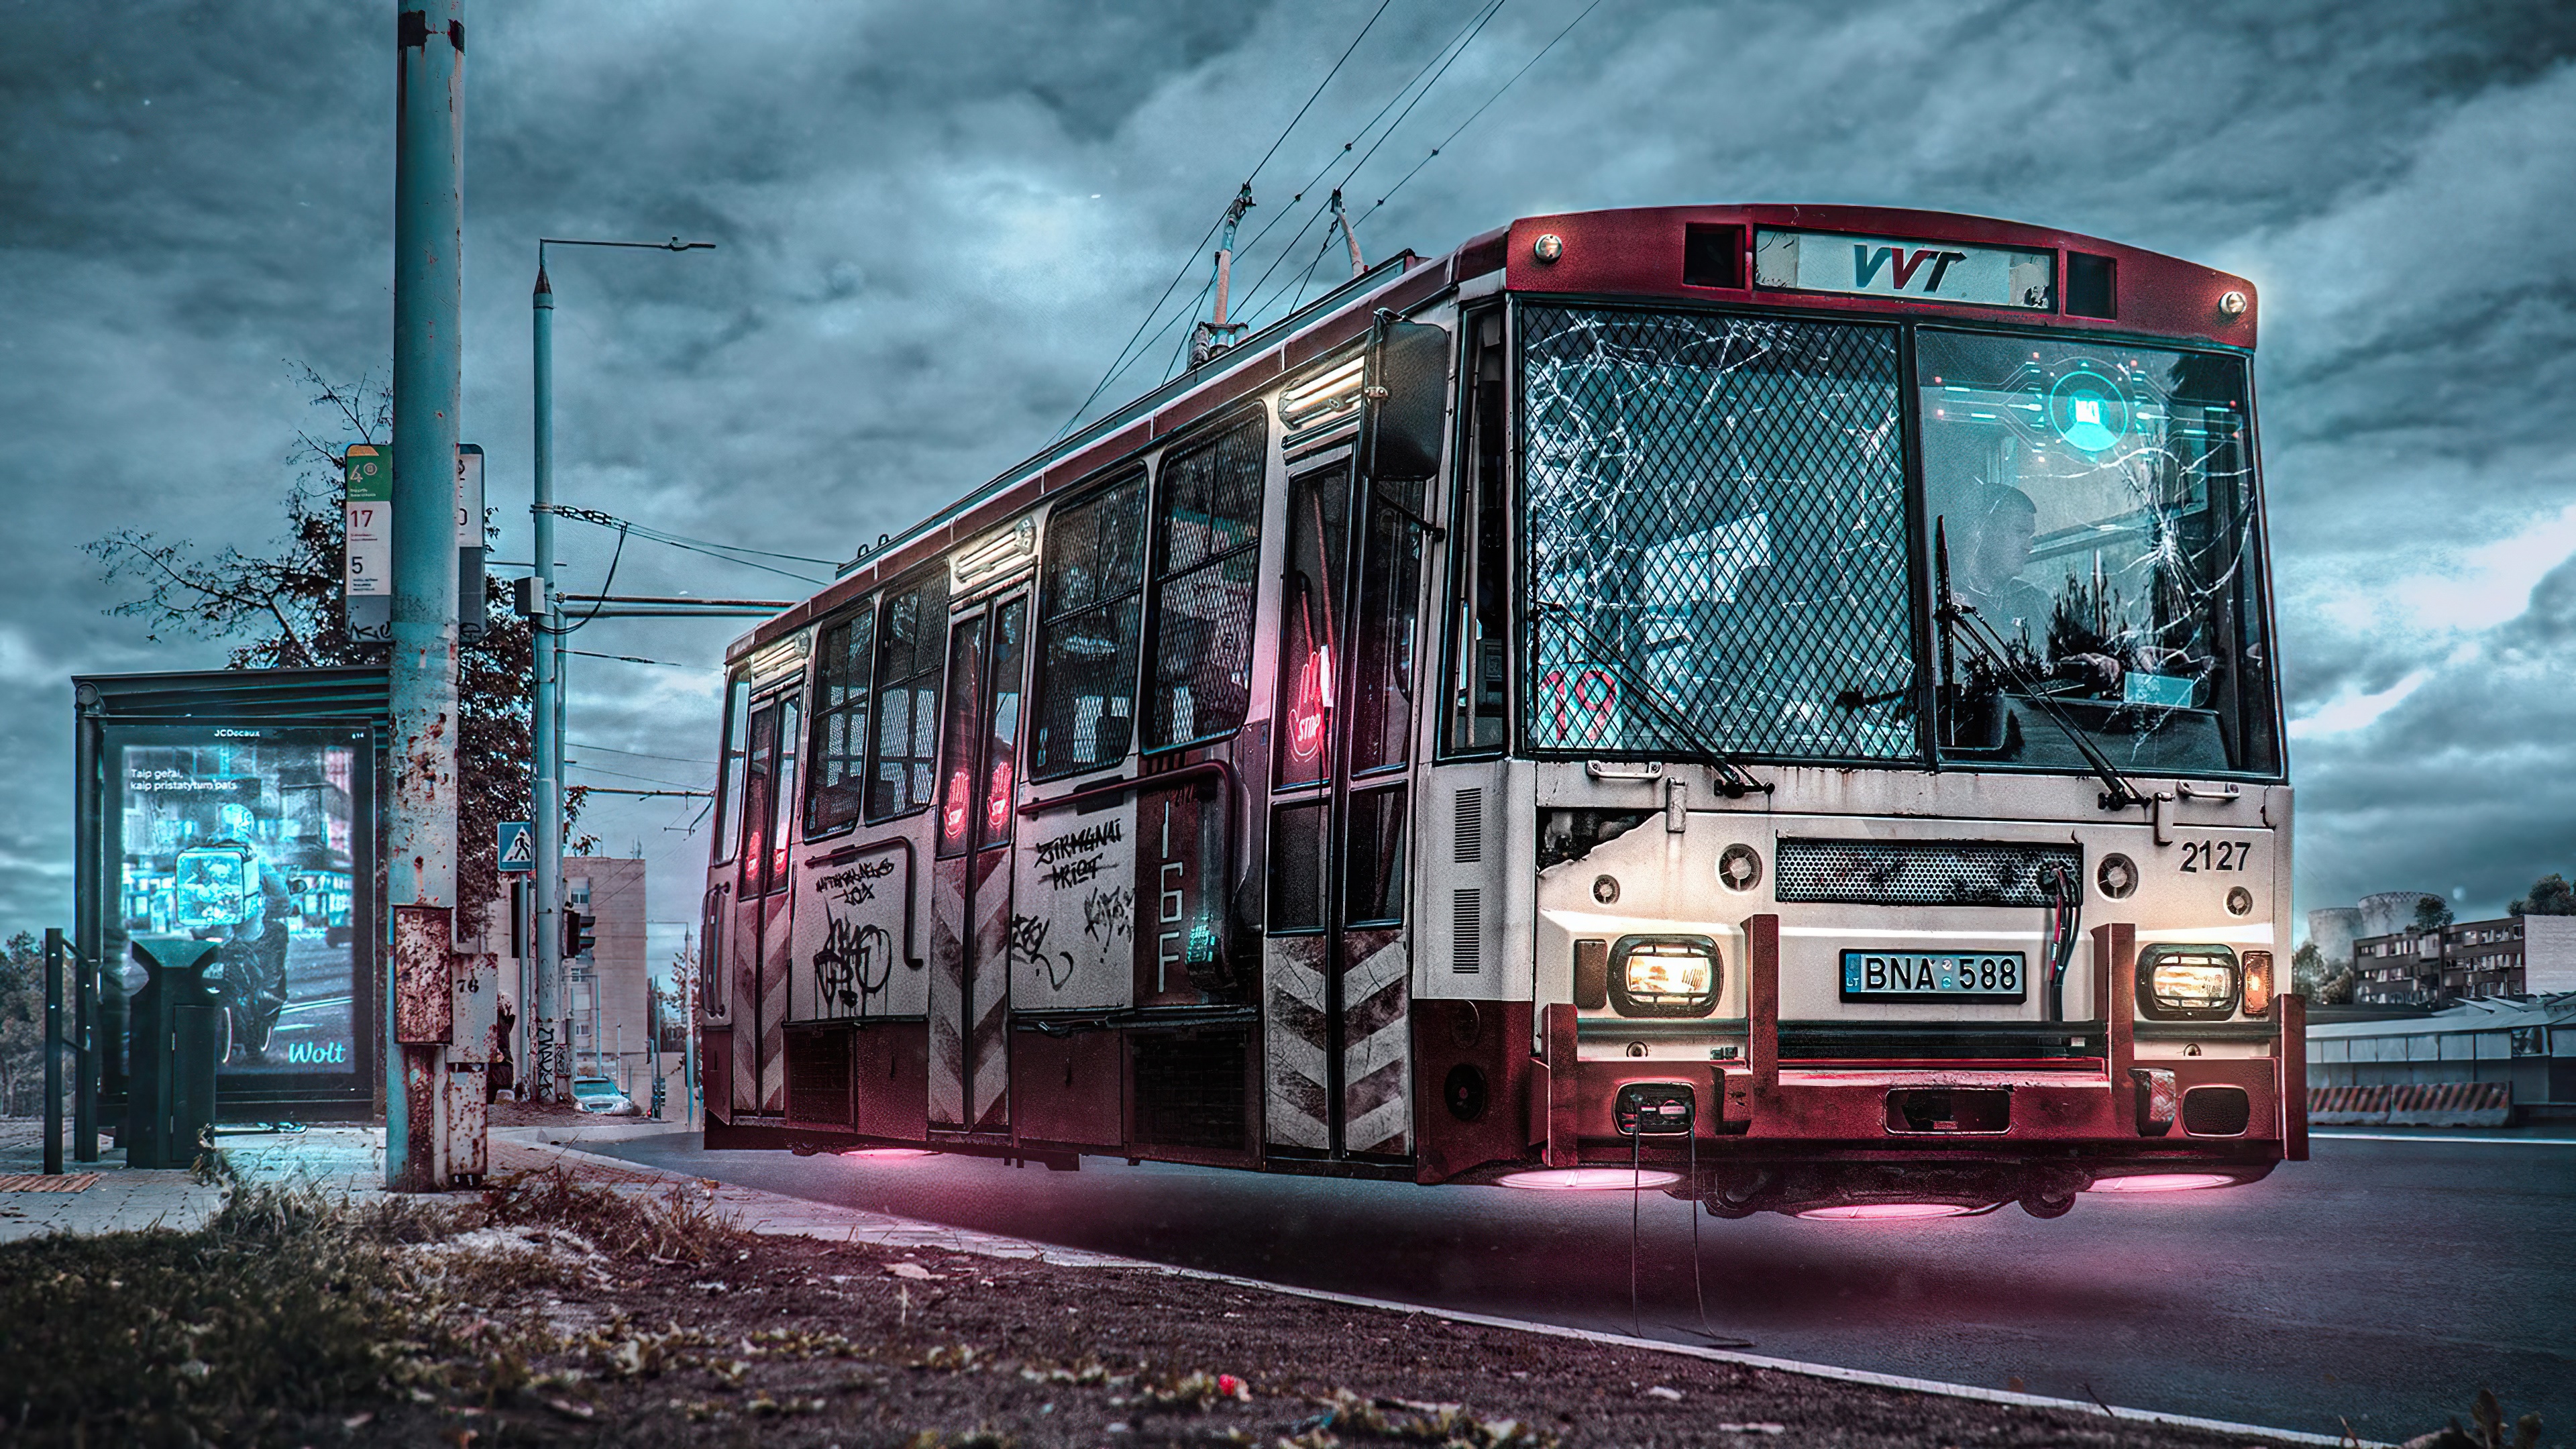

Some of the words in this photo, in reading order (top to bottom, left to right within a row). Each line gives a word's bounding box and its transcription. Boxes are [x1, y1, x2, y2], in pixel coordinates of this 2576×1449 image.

[1854, 244, 1967, 292] VVT
[351, 510, 373, 527] 17
[352, 556, 363, 574] 5
[1540, 671, 1617, 741] 19
[214, 729, 260, 737] JCDecaux
[1297, 713, 1321, 742] STOP
[131, 769, 152, 780] Taip
[130, 781, 152, 792] kaip
[2180, 840, 2251, 873] 2127
[1846, 977, 1860, 987] LT
[1867, 957, 1937, 989] BNA
[1960, 957, 2016, 989] 588
[457, 979, 479, 993] 76
[288, 1041, 346, 1063] Wolt
